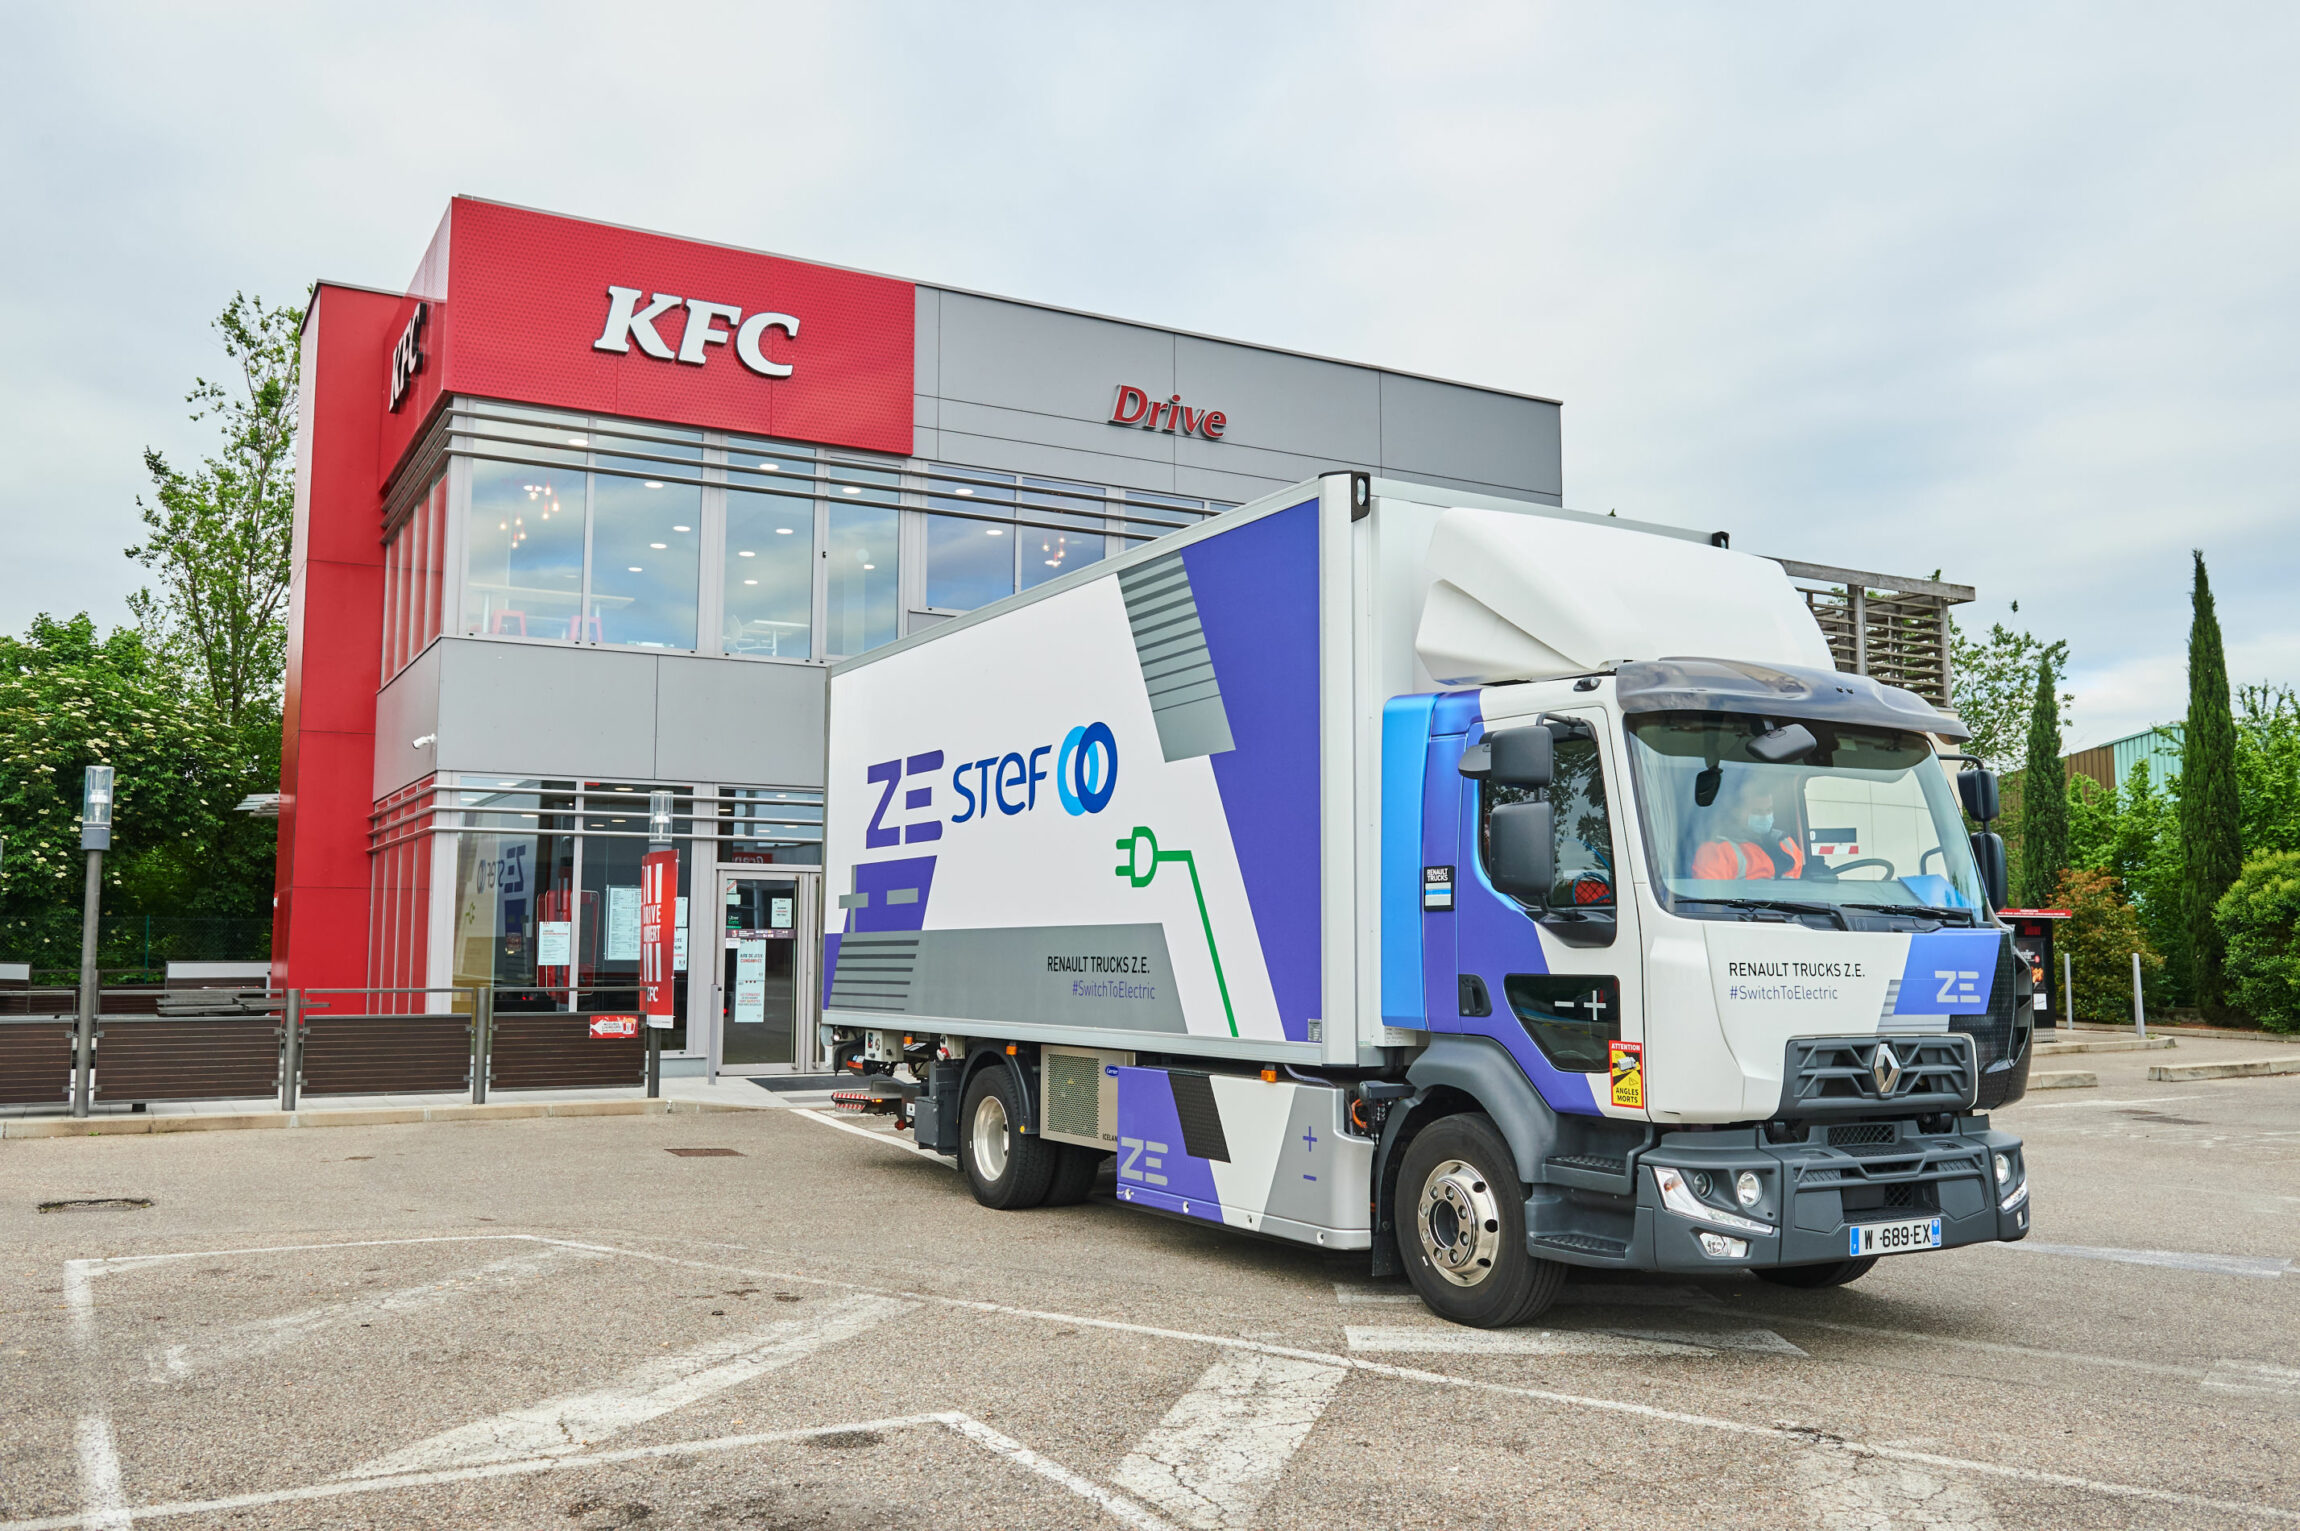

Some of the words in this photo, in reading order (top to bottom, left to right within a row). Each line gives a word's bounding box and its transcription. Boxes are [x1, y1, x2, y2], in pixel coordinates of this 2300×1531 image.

[593, 285, 800, 378] KFC
[388, 302, 425, 412] KFC
[1111, 384, 1227, 438] Drive
[866, 750, 944, 849] ZE
[1427, 868, 1448, 876] RENAULT
[1047, 956, 1088, 972] RENAULT
[1091, 956, 1129, 973] TRUCKS
[1131, 957, 1151, 973] Z.E.
[1729, 962, 1788, 976] RENAULT
[1793, 962, 1841, 977] TRUCKS
[1844, 963, 1865, 977] Z.E.
[1072, 980, 1155, 999] #SwitchToElectric
[1729, 985, 1838, 999] #SwitchToElectric
[1934, 970, 1981, 1004] ZE
[1611, 1043, 1641, 1051] ATTENTION
[1616, 1087, 1639, 1096] ANGLES
[1617, 1095, 1639, 1103] MORTS
[1120, 1136, 1168, 1186] ZE
